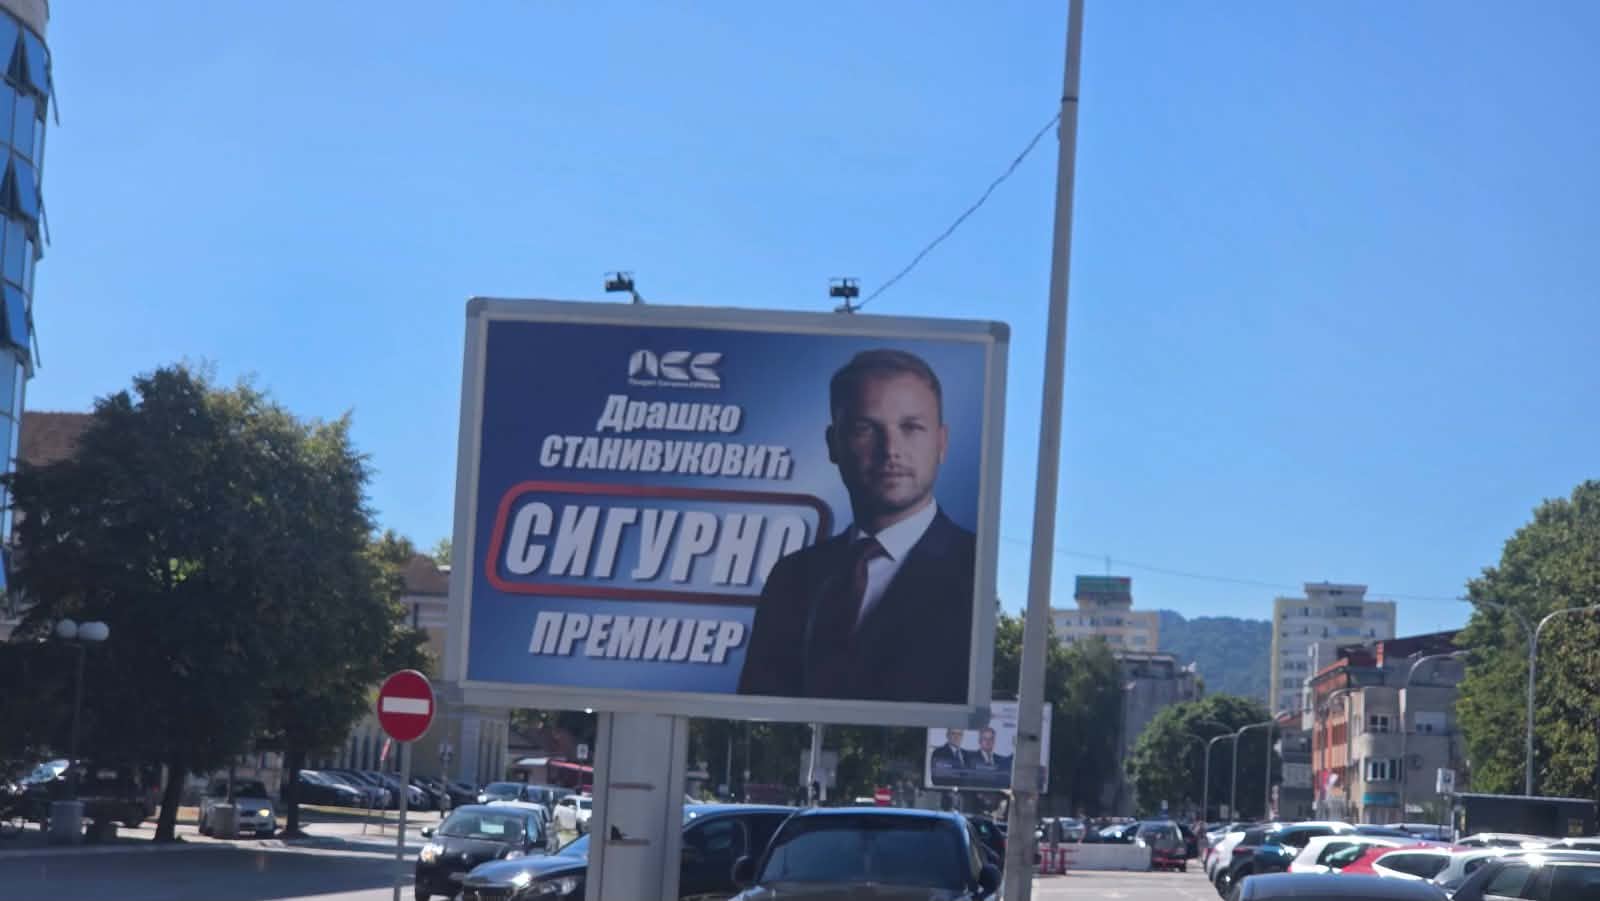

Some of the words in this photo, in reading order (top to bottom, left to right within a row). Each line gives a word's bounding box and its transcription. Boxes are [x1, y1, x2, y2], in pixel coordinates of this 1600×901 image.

[596, 394, 741, 432] Драшко
[539, 435, 793, 478] СТАНИВУКОВИЋ
[528, 611, 744, 664] ПРЕМИЈЕР
